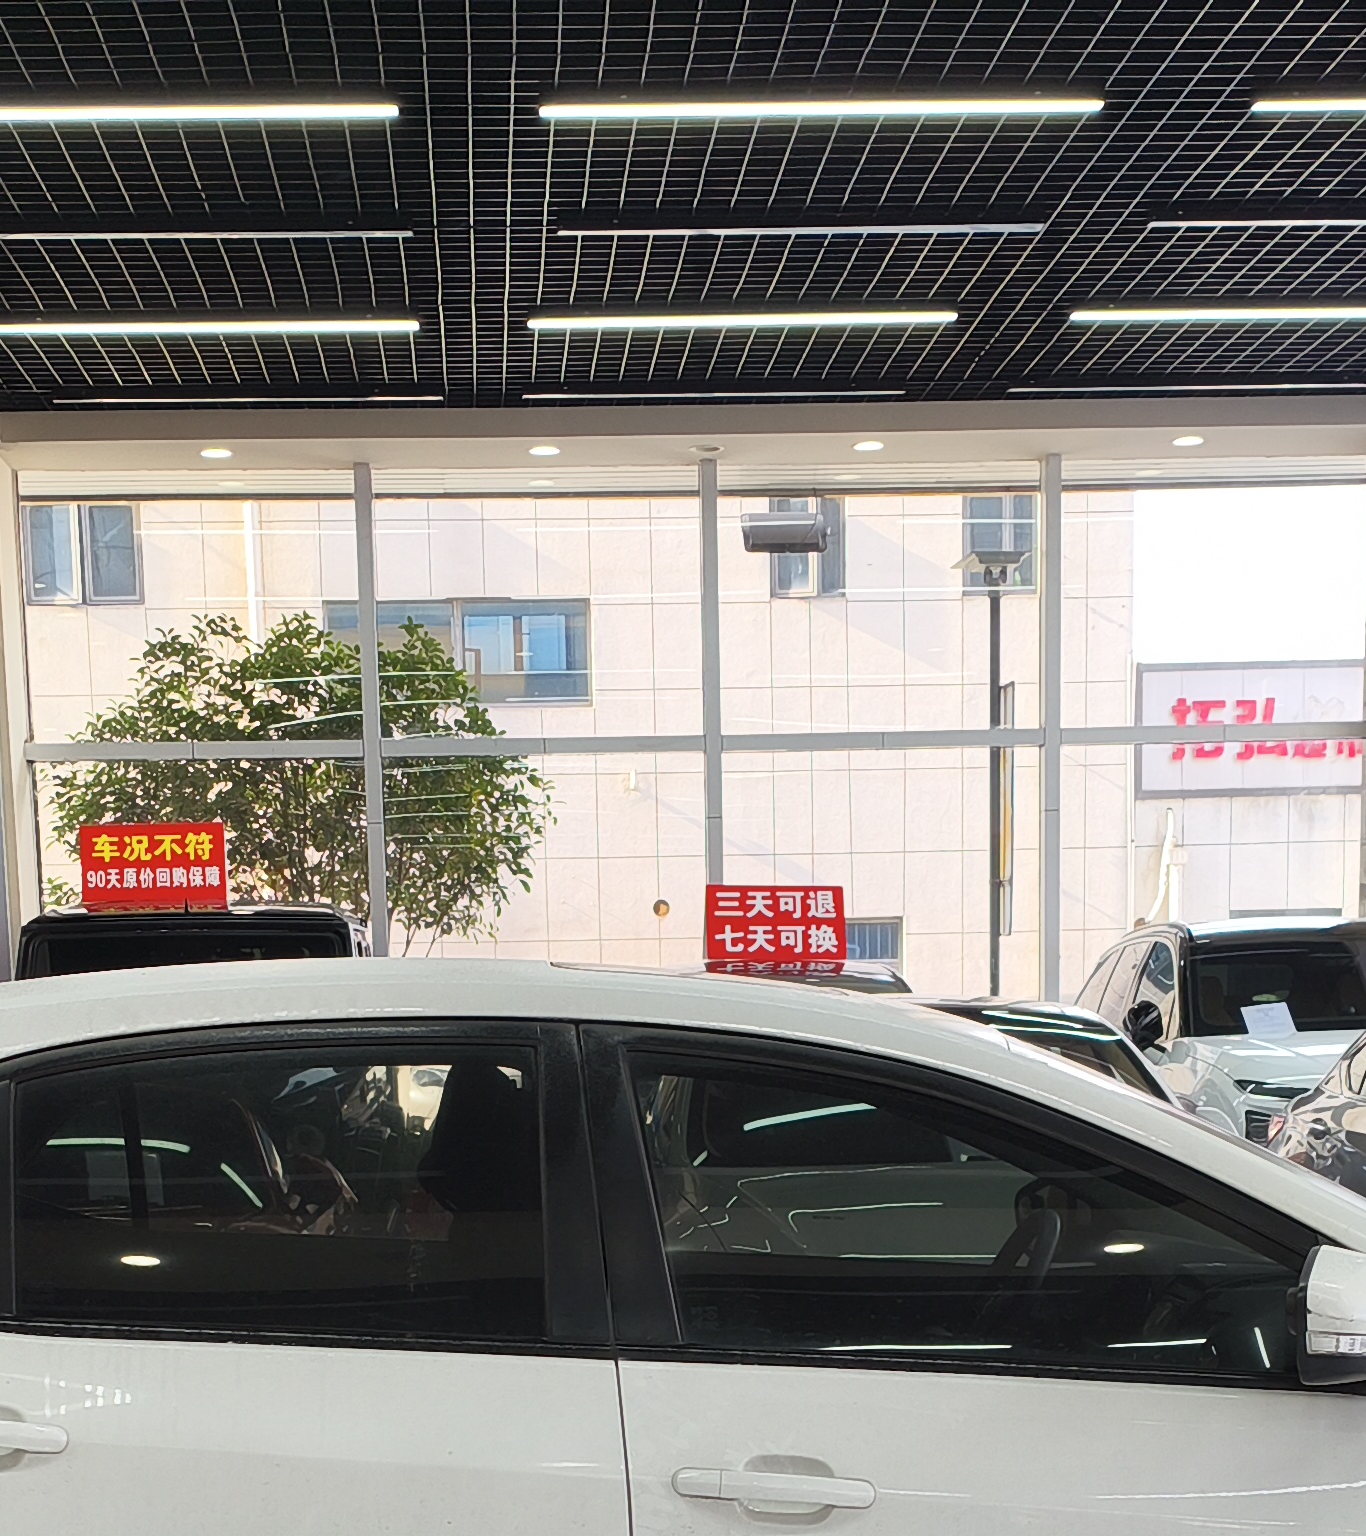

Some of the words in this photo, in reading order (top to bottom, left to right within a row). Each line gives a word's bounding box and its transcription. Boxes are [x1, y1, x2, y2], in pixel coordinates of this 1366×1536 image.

[91, 831, 213, 863] 车况不符
[87, 866, 221, 889] 90天原价回购保障
[714, 891, 837, 919] 三天可退
[714, 924, 839, 954] 七天可换
